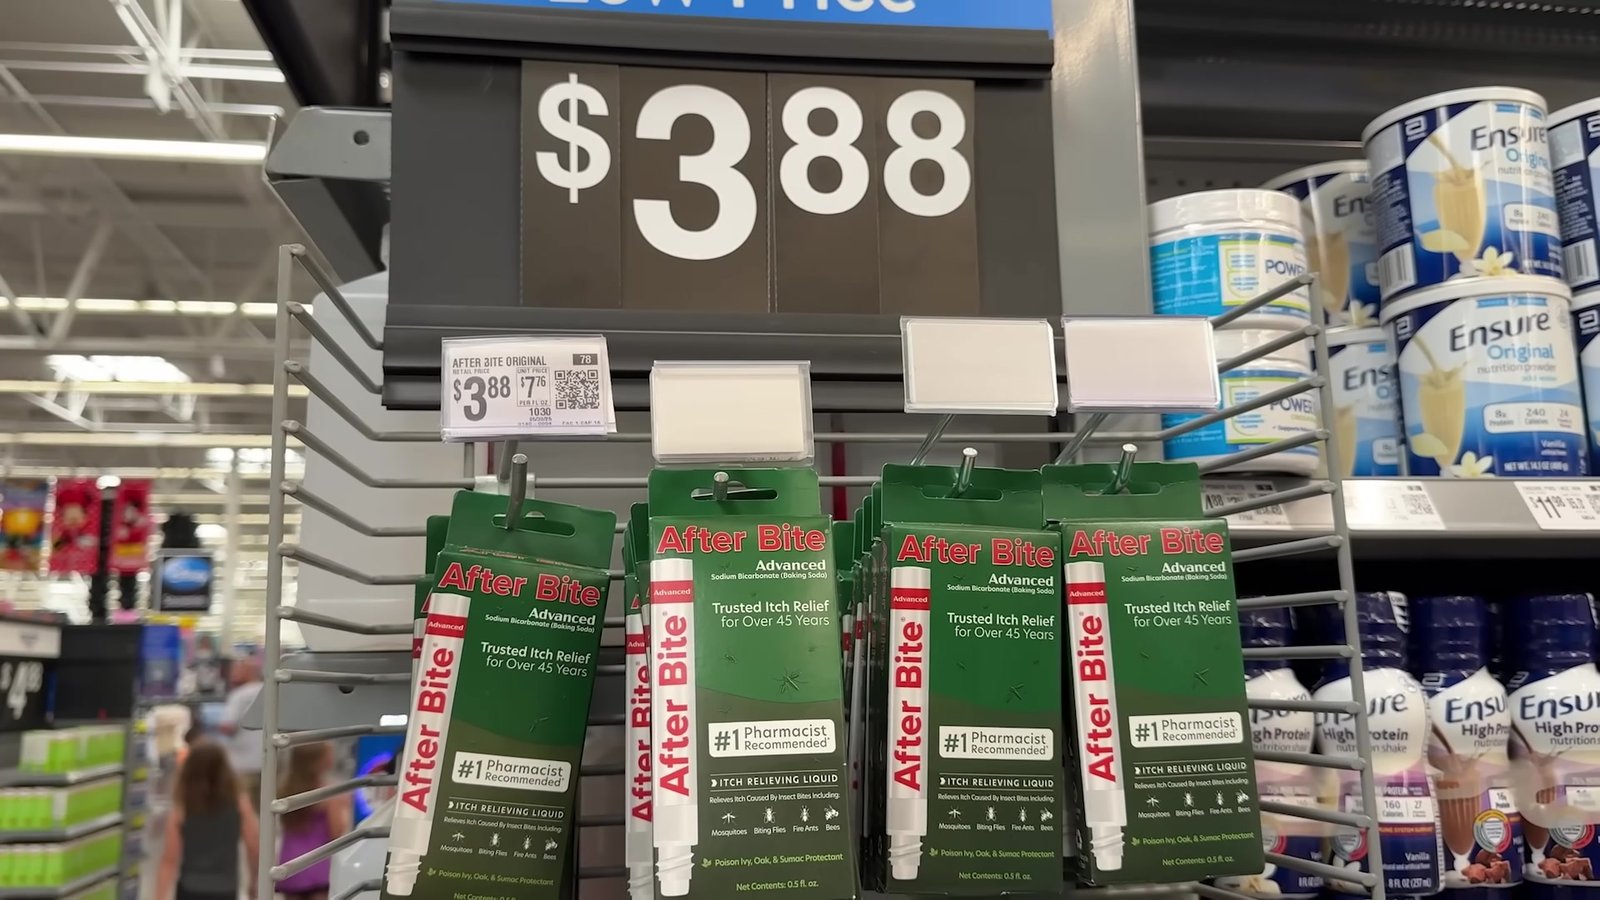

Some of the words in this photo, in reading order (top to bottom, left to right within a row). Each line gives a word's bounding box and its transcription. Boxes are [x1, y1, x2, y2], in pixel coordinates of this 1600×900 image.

[1450, 312, 1551, 352] Ensure
[1487, 344, 1554, 363] Original
[452, 358, 482, 368] AFTER
[484, 357, 503, 367] BITE
[506, 355, 547, 367] ORIGINAL
[580, 355, 592, 364] 78
[1477, 363, 1523, 375] nutrition
[529, 407, 551, 417] 1030
[656, 525, 746, 554] After
[758, 523, 826, 552] Bite
[1069, 529, 1151, 558] After
[1160, 527, 1224, 554] Bite
[897, 534, 981, 565] After
[991, 537, 1054, 567] Bite
[756, 560, 826, 571] Advanced
[1162, 561, 1226, 573] Advanced
[738, 572, 780, 580] Bicarbonate
[780, 572, 806, 581] (Baking
[808, 572, 828, 580] Soda)
[988, 573, 1054, 587] Advanced
[438, 562, 527, 597] After
[535, 573, 601, 607] Bite
[653, 588, 691, 596] Advanced
[893, 595, 928, 603] Advanced
[712, 602, 762, 614] Trusted
[765, 601, 790, 613] Itch
[793, 600, 830, 613] Relief
[1124, 602, 1171, 614] Trusted
[1173, 601, 1196, 613] Itch
[1198, 600, 1231, 612] Relief
[529, 607, 596, 626] Advanced
[721, 616, 739, 628] for
[742, 616, 774, 627] Over
[776, 615, 792, 626] 45
[795, 614, 830, 626] Years
[947, 612, 993, 625] Trusted
[996, 613, 1019, 626] Itch
[1022, 614, 1055, 627] Relief
[1133, 616, 1150, 627] for
[1153, 615, 1181, 626] Over
[1184, 615, 1199, 625] 45
[1201, 614, 1232, 625] Years
[427, 621, 464, 631] Advanced
[954, 625, 971, 637] for
[974, 627, 1002, 638] Over
[1005, 627, 1021, 639] 45
[1022, 628, 1054, 640] Years
[481, 641, 528, 658] Trusted
[530, 645, 554, 661] Itch
[556, 649, 592, 664] Relief
[657, 615, 688, 686] Bite
[895, 621, 923, 689] Bite
[1077, 615, 1107, 682] Bite
[486, 656, 503, 668] for
[506, 658, 535, 672] Over
[538, 661, 553, 673] 45
[556, 663, 588, 678] Years
[417, 647, 454, 714] Bite
[1135, 721, 1159, 742] #1
[1161, 717, 1235, 731] Pharmacist
[1274, 728, 1311, 740] Protein
[1323, 728, 1355, 743] High
[1462, 724, 1494, 738] High
[1535, 722, 1573, 736] High
[714, 729, 740, 751] #1
[744, 724, 827, 739] Pharmacist
[944, 733, 968, 753] #1
[971, 731, 1046, 745] Pharmacist
[1086, 693, 1116, 783] After
[1550, 736, 1596, 746] nutrition
[660, 701, 690, 797] After
[893, 700, 922, 792] After
[1381, 743, 1407, 752] shake
[401, 724, 440, 814] After
[457, 759, 482, 779] #1
[486, 759, 564, 778] Pharmacist
[1142, 766, 1164, 774] ITCH
[1167, 763, 1215, 773] RELIEVING
[1216, 762, 1247, 771] LIQUID
[719, 778, 743, 787] ITCH
[747, 775, 800, 786] RELIEVING
[803, 774, 838, 784] LIQUID
[947, 778, 969, 786] ITCH
[972, 778, 1020, 787] RELIEVING
[1022, 779, 1054, 788] LIQUID
[709, 796, 733, 804] Relieves
[734, 795, 746, 803] Itch
[746, 794, 769, 802] Caused
[770, 794, 778, 803] By
[778, 793, 796, 801] Insect
[1385, 800, 1401, 809] 160
[455, 802, 477, 811] ITCH
[481, 803, 529, 816] RELIEVING
[532, 806, 565, 819] LIQUID
[711, 828, 748, 837] Mosquitoes
[753, 827, 772, 836] Biting
[773, 826, 787, 834] Flies
[792, 825, 804, 833] Fire
[825, 823, 841, 832] Bees
[714, 858, 739, 867] Poison
[740, 858, 753, 867] Ivy,
[753, 857, 773, 865] Oak,
[779, 855, 804, 863] Sumac
[805, 853, 843, 862] Protectant
[1405, 852, 1430, 861] Vanilla
[736, 883, 751, 891] Net
[751, 881, 786, 891] Contents:
[800, 880, 808, 888] fl.
